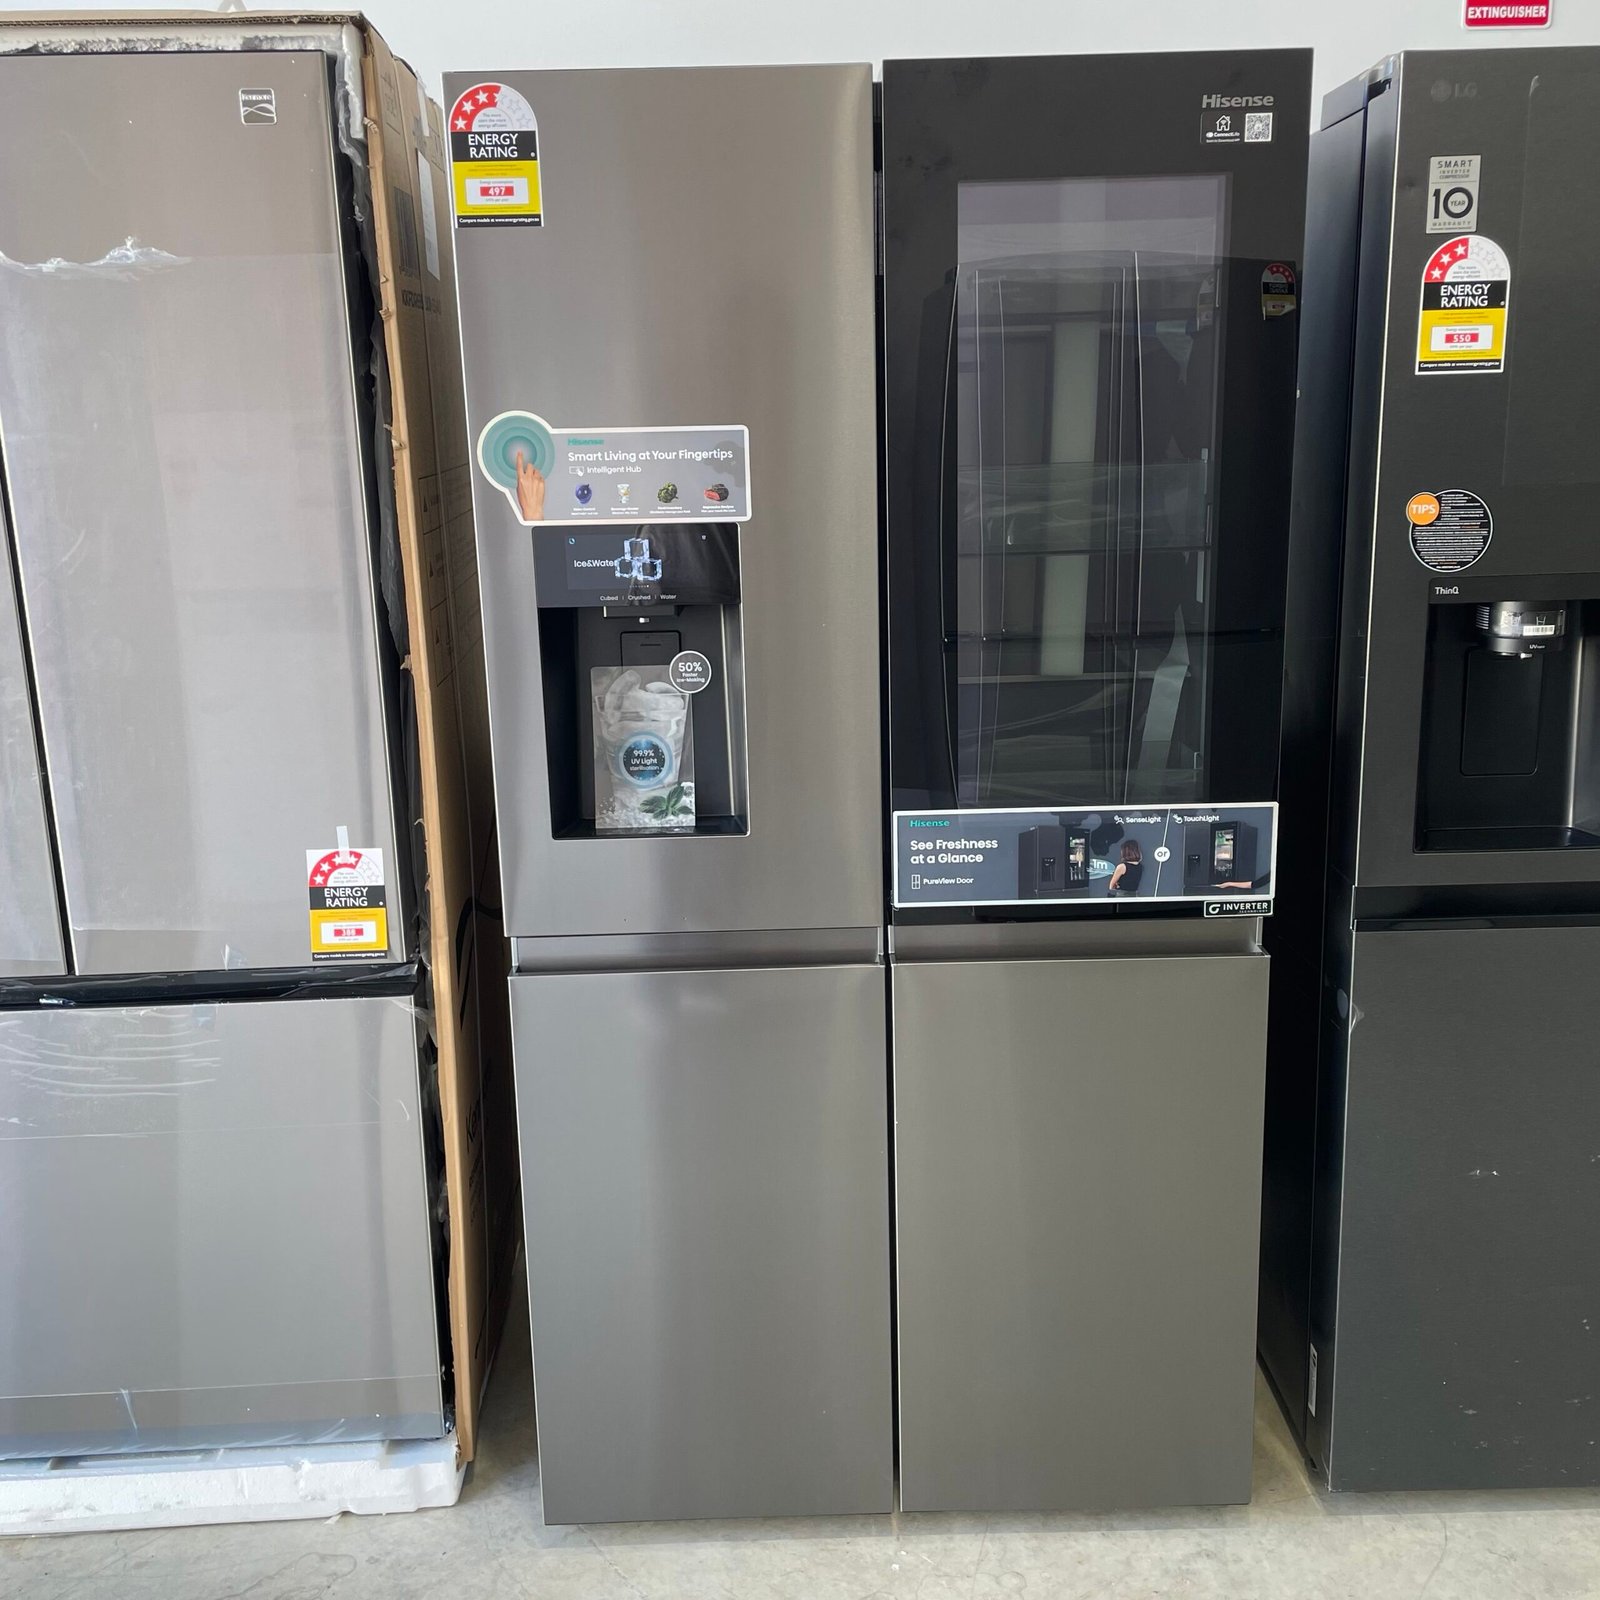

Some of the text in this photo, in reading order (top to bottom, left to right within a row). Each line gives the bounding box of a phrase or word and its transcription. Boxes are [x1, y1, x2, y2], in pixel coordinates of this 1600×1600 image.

[1467, 6, 1547, 19] EXTINGUISHER
[1455, 82, 1478, 98] LG
[1202, 94, 1274, 109] Hisense
[468, 133, 518, 146] ENERGY
[469, 146, 518, 158] RATING
[1437, 160, 1472, 169] SMART
[488, 186, 506, 196] 497
[1432, 187, 1473, 219] 10
[1440, 284, 1491, 296] ENERGY
[1440, 296, 1488, 308] RATING
[1453, 334, 1471, 343] 550
[568, 448, 734, 463] Smart Living at Your Fingertips
[586, 465, 642, 475] Intelligent Hub
[1411, 504, 1436, 514] TIPS
[1434, 586, 1460, 595] ThinQ
[678, 661, 702, 672] 50%
[633, 749, 655, 757] 99.9%
[631, 757, 658, 767] UV Light
[909, 819, 950, 828] Hisense
[1183, 814, 1220, 823] TouchLight
[910, 838, 999, 851] See Freshness
[910, 852, 984, 865] at a Glance
[1156, 850, 1168, 858] or
[922, 876, 975, 886] PureView Door
[324, 887, 368, 897] ENERGY
[326, 897, 368, 907] RATING
[1223, 902, 1269, 911] INVERTER
